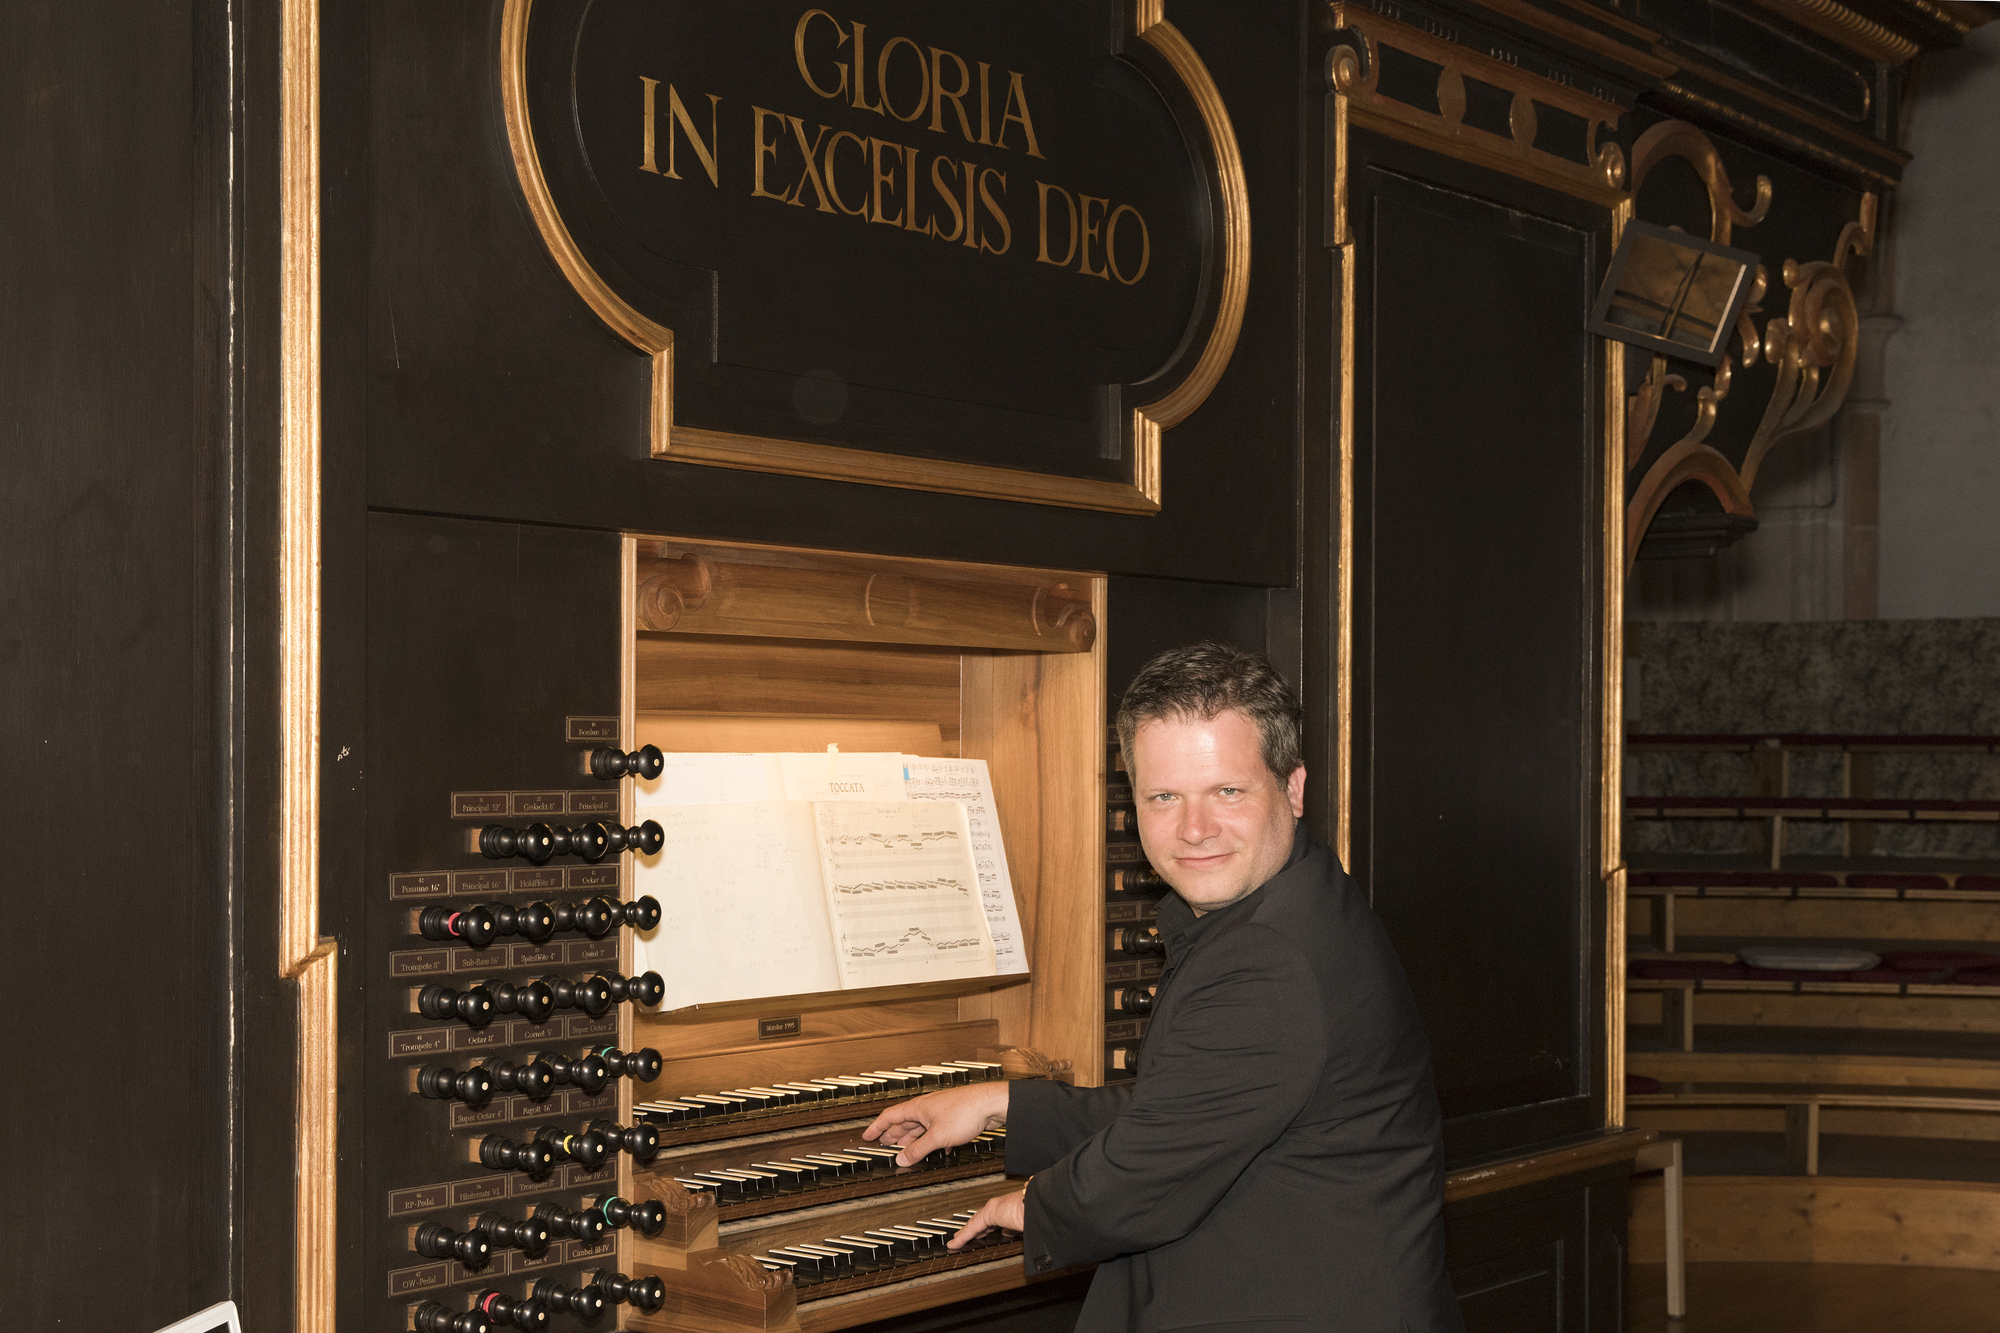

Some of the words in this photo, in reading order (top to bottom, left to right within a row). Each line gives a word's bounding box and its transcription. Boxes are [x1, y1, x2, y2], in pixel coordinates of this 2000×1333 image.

[794, 8, 1047, 160] GLORIA
[639, 75, 723, 189] IN
[751, 104, 1012, 255] EXCELSIS
[1035, 180, 1150, 285] DEO
[829, 782, 866, 793] TOCCATA
[462, 804, 489, 813] Principal
[523, 802, 549, 811] Gedackt
[578, 802, 604, 811] Principal
[401, 885, 429, 893] Posaune
[462, 881, 490, 891] Principal
[400, 962, 432, 972] Trompete
[462, 957, 490, 967] Sub-Bass
[547, 1029, 553, 1037] V
[571, 1026, 589, 1035] Super
[589, 1024, 608, 1033] Octav
[400, 1041, 433, 1052] Trompete
[577, 1100, 591, 1108] Terz
[522, 1106, 542, 1116] Fagott
[457, 1115, 475, 1124] Super
[477, 1112, 496, 1121] Octav
[518, 1181, 549, 1191] Trompete
[459, 1190, 491, 1201] Hintersatz
[491, 1187, 500, 1196] VI
[405, 1197, 435, 1210] RP-Pedal
[572, 1247, 593, 1258] Cimbel
[594, 1243, 610, 1254] III-IV
[402, 1275, 437, 1289] OW-Pedal
